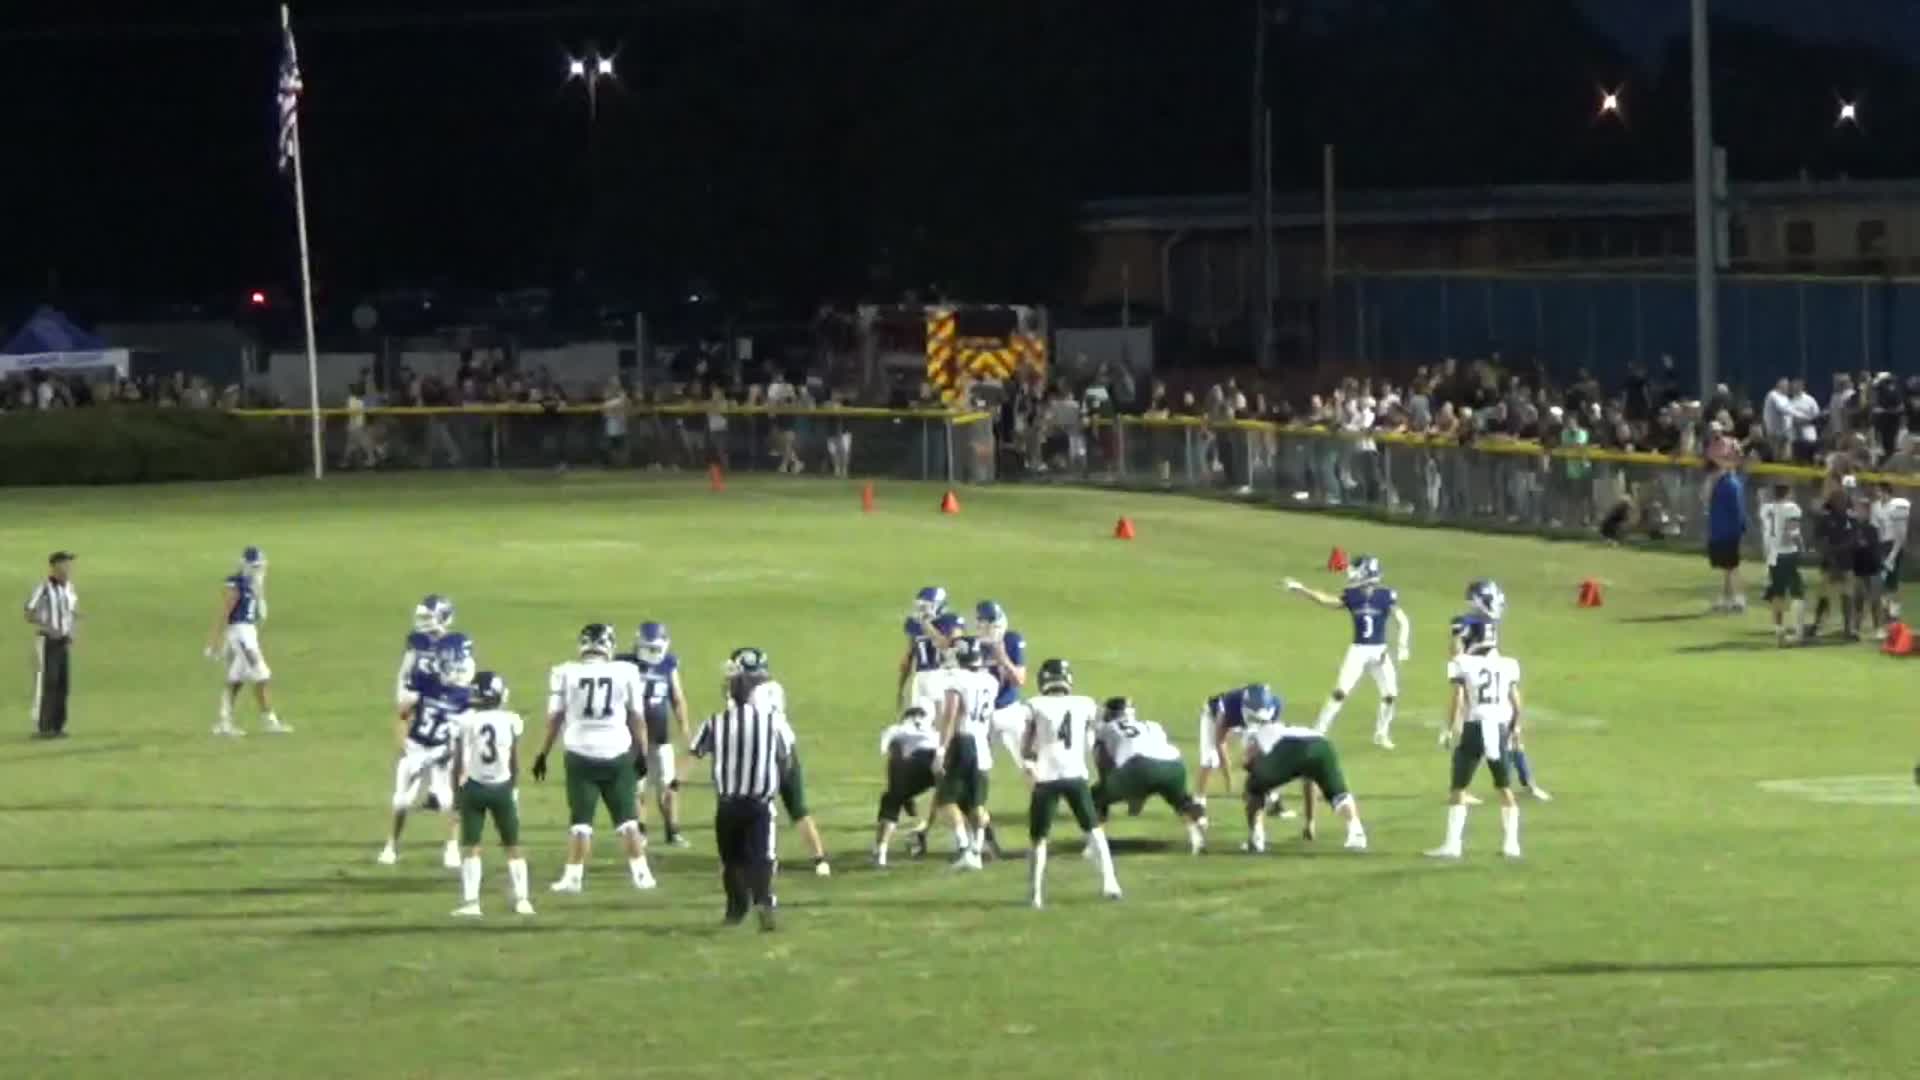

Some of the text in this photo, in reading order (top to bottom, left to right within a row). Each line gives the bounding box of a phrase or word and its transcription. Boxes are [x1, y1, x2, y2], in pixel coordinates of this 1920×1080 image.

[579, 677, 614, 719] 77
[1478, 667, 1501, 705] 21
[480, 724, 498, 765] 3
[1057, 709, 1072, 750] 4
